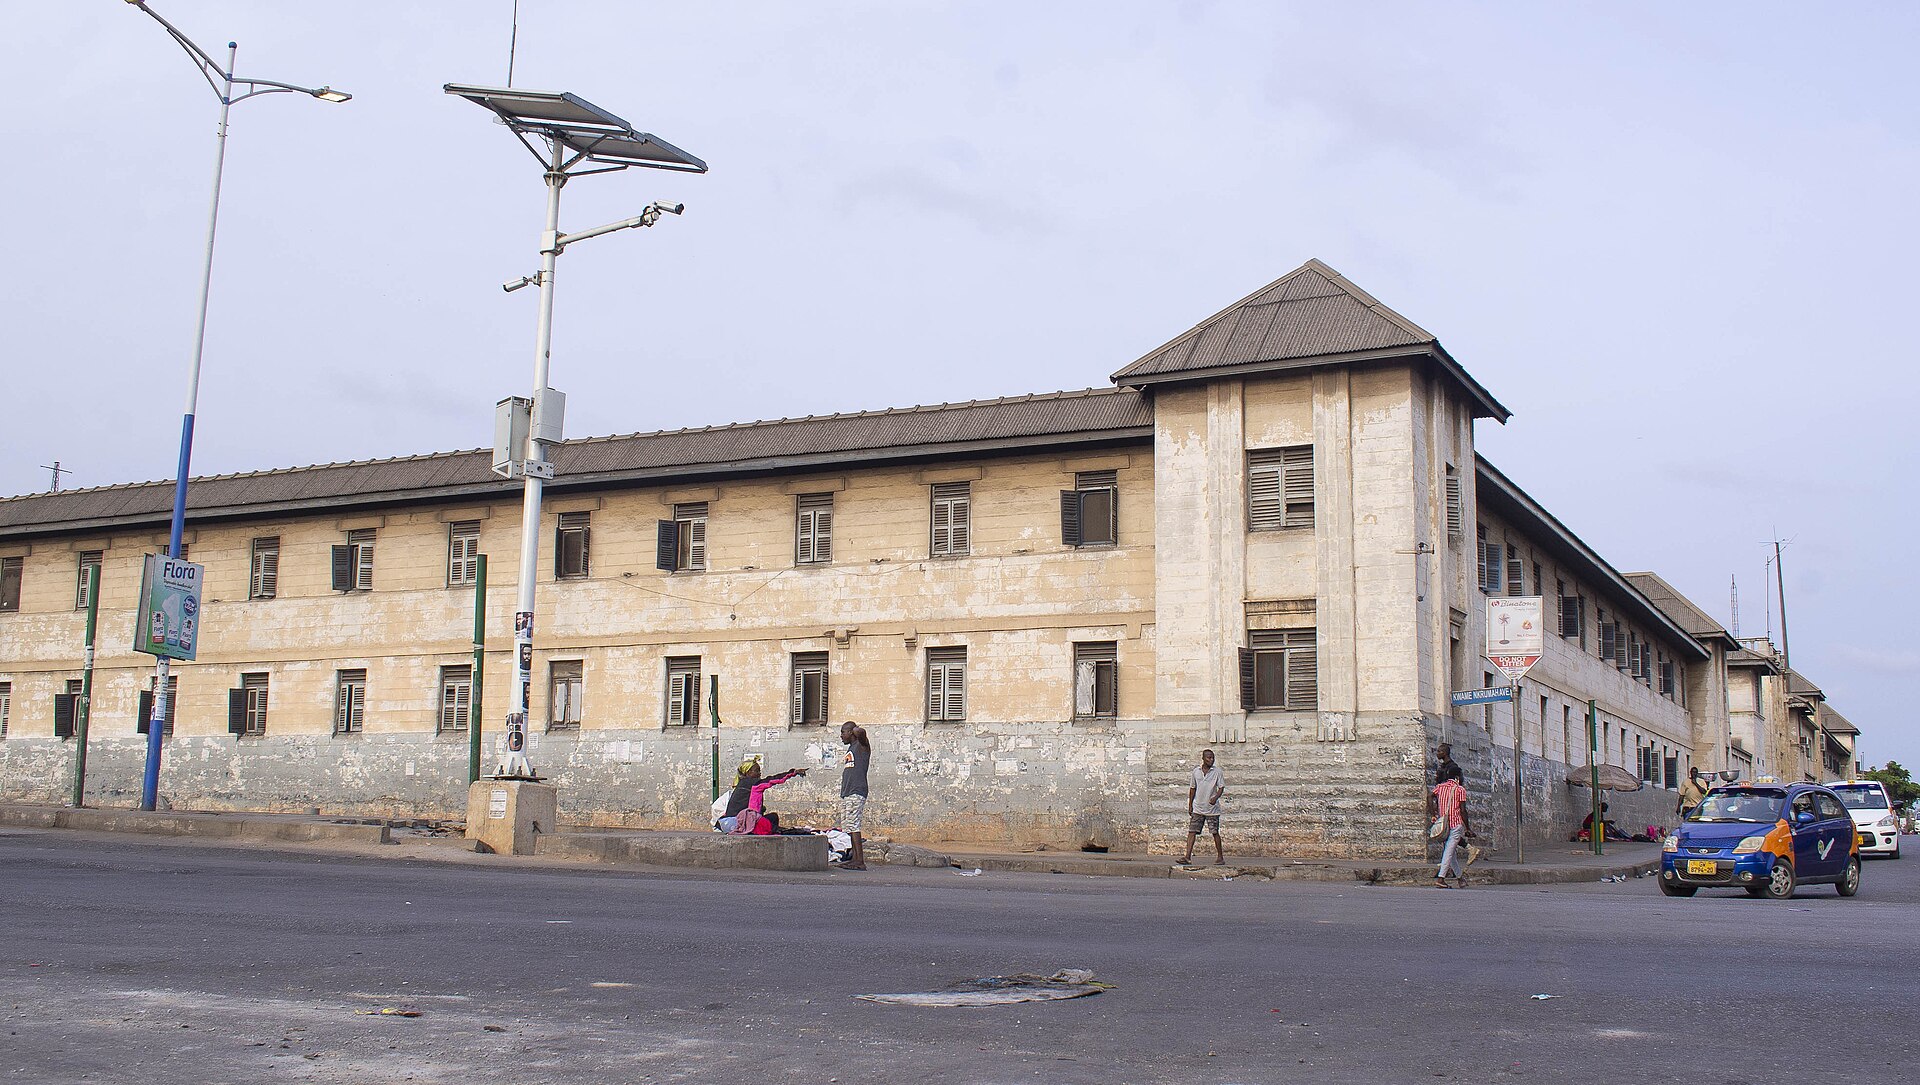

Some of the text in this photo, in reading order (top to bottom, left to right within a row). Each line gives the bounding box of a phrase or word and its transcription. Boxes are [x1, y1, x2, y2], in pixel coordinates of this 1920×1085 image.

[164, 562, 195, 579] Flora
[1452, 687, 1510, 700] KWAME NKRUMAH AVE
